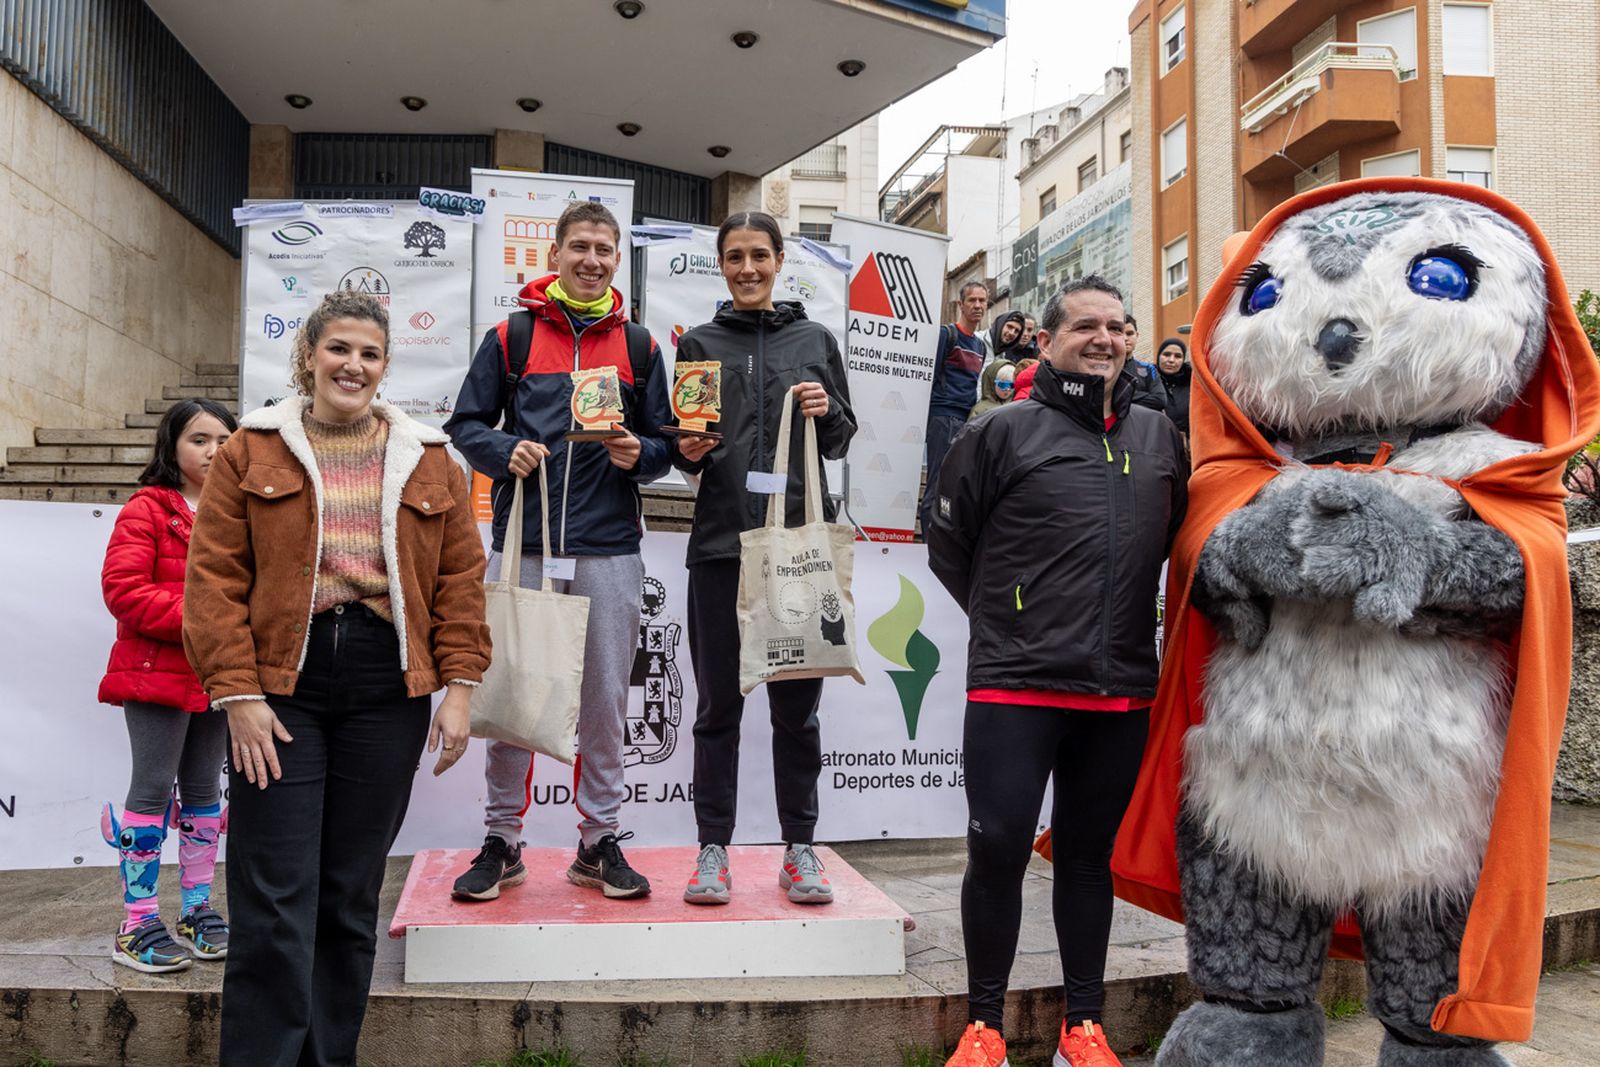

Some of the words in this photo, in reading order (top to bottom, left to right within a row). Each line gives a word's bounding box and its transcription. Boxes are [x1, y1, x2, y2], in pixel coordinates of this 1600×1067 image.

[321, 206, 390, 214] PATROCINADORES
[420, 190, 486, 215] GRACIAS!
[1014, 244, 1037, 273] COS
[848, 318, 919, 343] AJDEM
[391, 336, 451, 348] copiservic
[848, 345, 882, 360] IACIÓN
[884, 351, 934, 368] JIENNENSE
[848, 360, 890, 376] CLEROSIS
[892, 366, 932, 381] MÚLTIPLE
[1063, 381, 1084, 396] HH
[791, 552, 811, 565] AULA
[811, 548, 820, 559] DE
[666, 629, 674, 657] CASTILLA
[820, 750, 896, 767] atronato
[902, 748, 964, 769] Municip
[833, 772, 915, 793] Deportes
[920, 770, 943, 788] de
[948, 770, 966, 788] Ja
